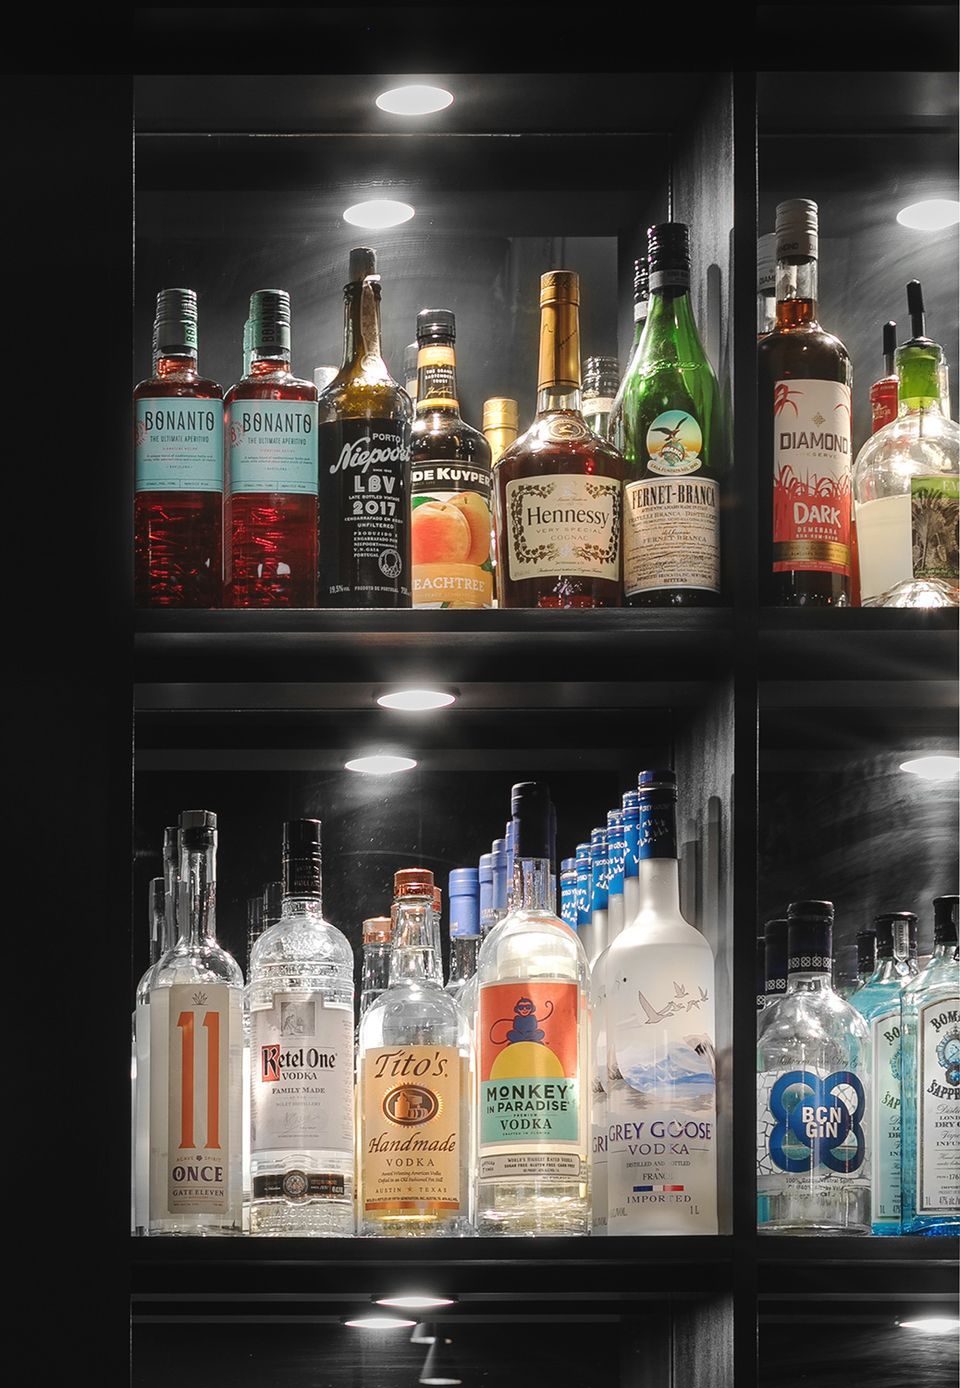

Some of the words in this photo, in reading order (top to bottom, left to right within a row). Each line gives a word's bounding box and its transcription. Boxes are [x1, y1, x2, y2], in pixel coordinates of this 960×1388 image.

[145, 410, 215, 431] BONANTO
[243, 412, 312, 434] BONANTO
[372, 433, 401, 444] PORTO
[779, 432, 848, 454] DIAMOND
[329, 437, 411, 474] Niepoort
[354, 475, 396, 494] LBV
[412, 467, 433, 482] DE
[437, 467, 490, 487] KUYPER
[632, 484, 715, 509] FERNET-BRANCA
[353, 500, 396, 516] 2017
[527, 506, 610, 529] Hennessy
[794, 502, 842, 528] DARK
[565, 527, 602, 535] SPECIAL
[413, 577, 485, 593] EACHTREE
[930, 1010, 959, 1033] BOM
[263, 1048, 304, 1078] Ketel
[306, 1048, 336, 1069] One
[374, 1049, 446, 1078] Tito's
[177, 1010, 222, 1150] 11
[282, 1072, 318, 1081] VODKA
[486, 1084, 568, 1102] MONKEY
[486, 1105, 495, 1114] IN
[497, 1100, 568, 1113] PARADISE
[802, 1106, 842, 1124] BCN
[500, 1118, 553, 1130] VODKA
[609, 1122, 645, 1142] GREY
[650, 1121, 712, 1140] GOOSE
[368, 1131, 456, 1154] Handmade
[628, 1143, 690, 1155] VODKA
[386, 1158, 435, 1167] VODKA
[172, 1165, 223, 1182] ONCE
[195, 1189, 224, 1197] ELEVEN
[626, 1194, 692, 1204] IMPORTED
